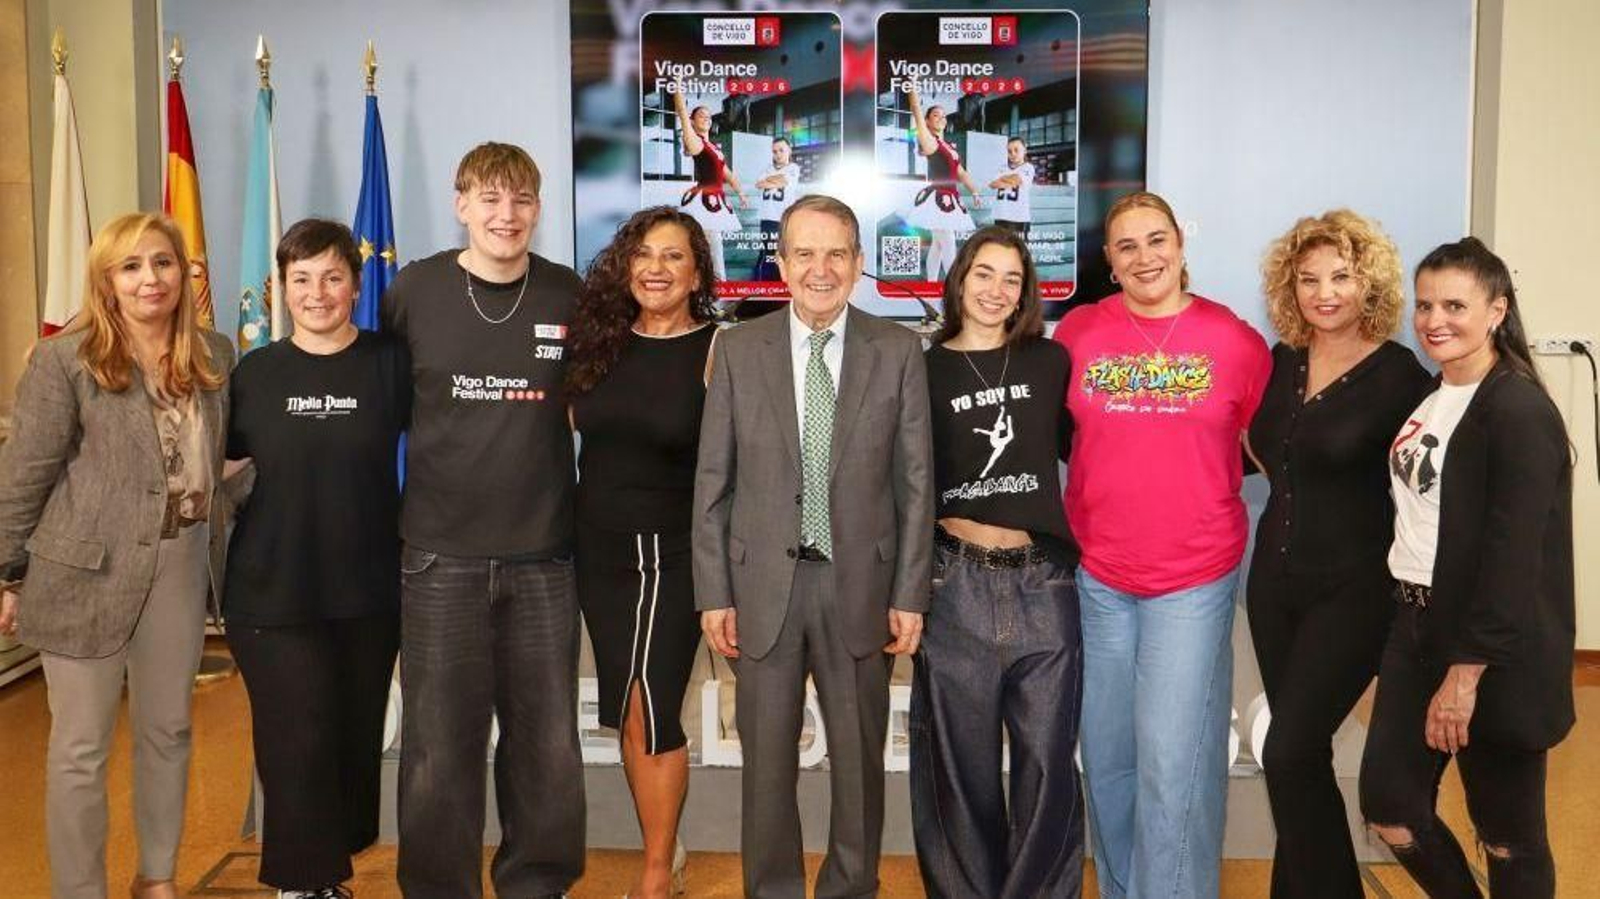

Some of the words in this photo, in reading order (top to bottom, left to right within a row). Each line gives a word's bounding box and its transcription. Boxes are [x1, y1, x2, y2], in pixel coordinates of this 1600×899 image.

[706, 23, 751, 32] CONCELLO
[943, 22, 988, 31] CONCELLO
[712, 32, 724, 40] DE
[726, 32, 747, 40] VIGO
[948, 31, 960, 39] DE
[962, 31, 983, 39] VIGO
[654, 60, 695, 79] Vigo
[700, 60, 758, 76] Dance
[889, 59, 932, 78] Vigo
[936, 59, 994, 76] Dance
[655, 77, 725, 94] Festival
[729, 82, 786, 93] 2026
[890, 77, 960, 94] Festival
[452, 374, 483, 390] Vigo
[485, 375, 529, 388] Dance
[452, 386, 503, 400] Festival
[951, 394, 973, 413] YO
[975, 387, 1006, 407] SOY
[1009, 384, 1032, 399] DE
